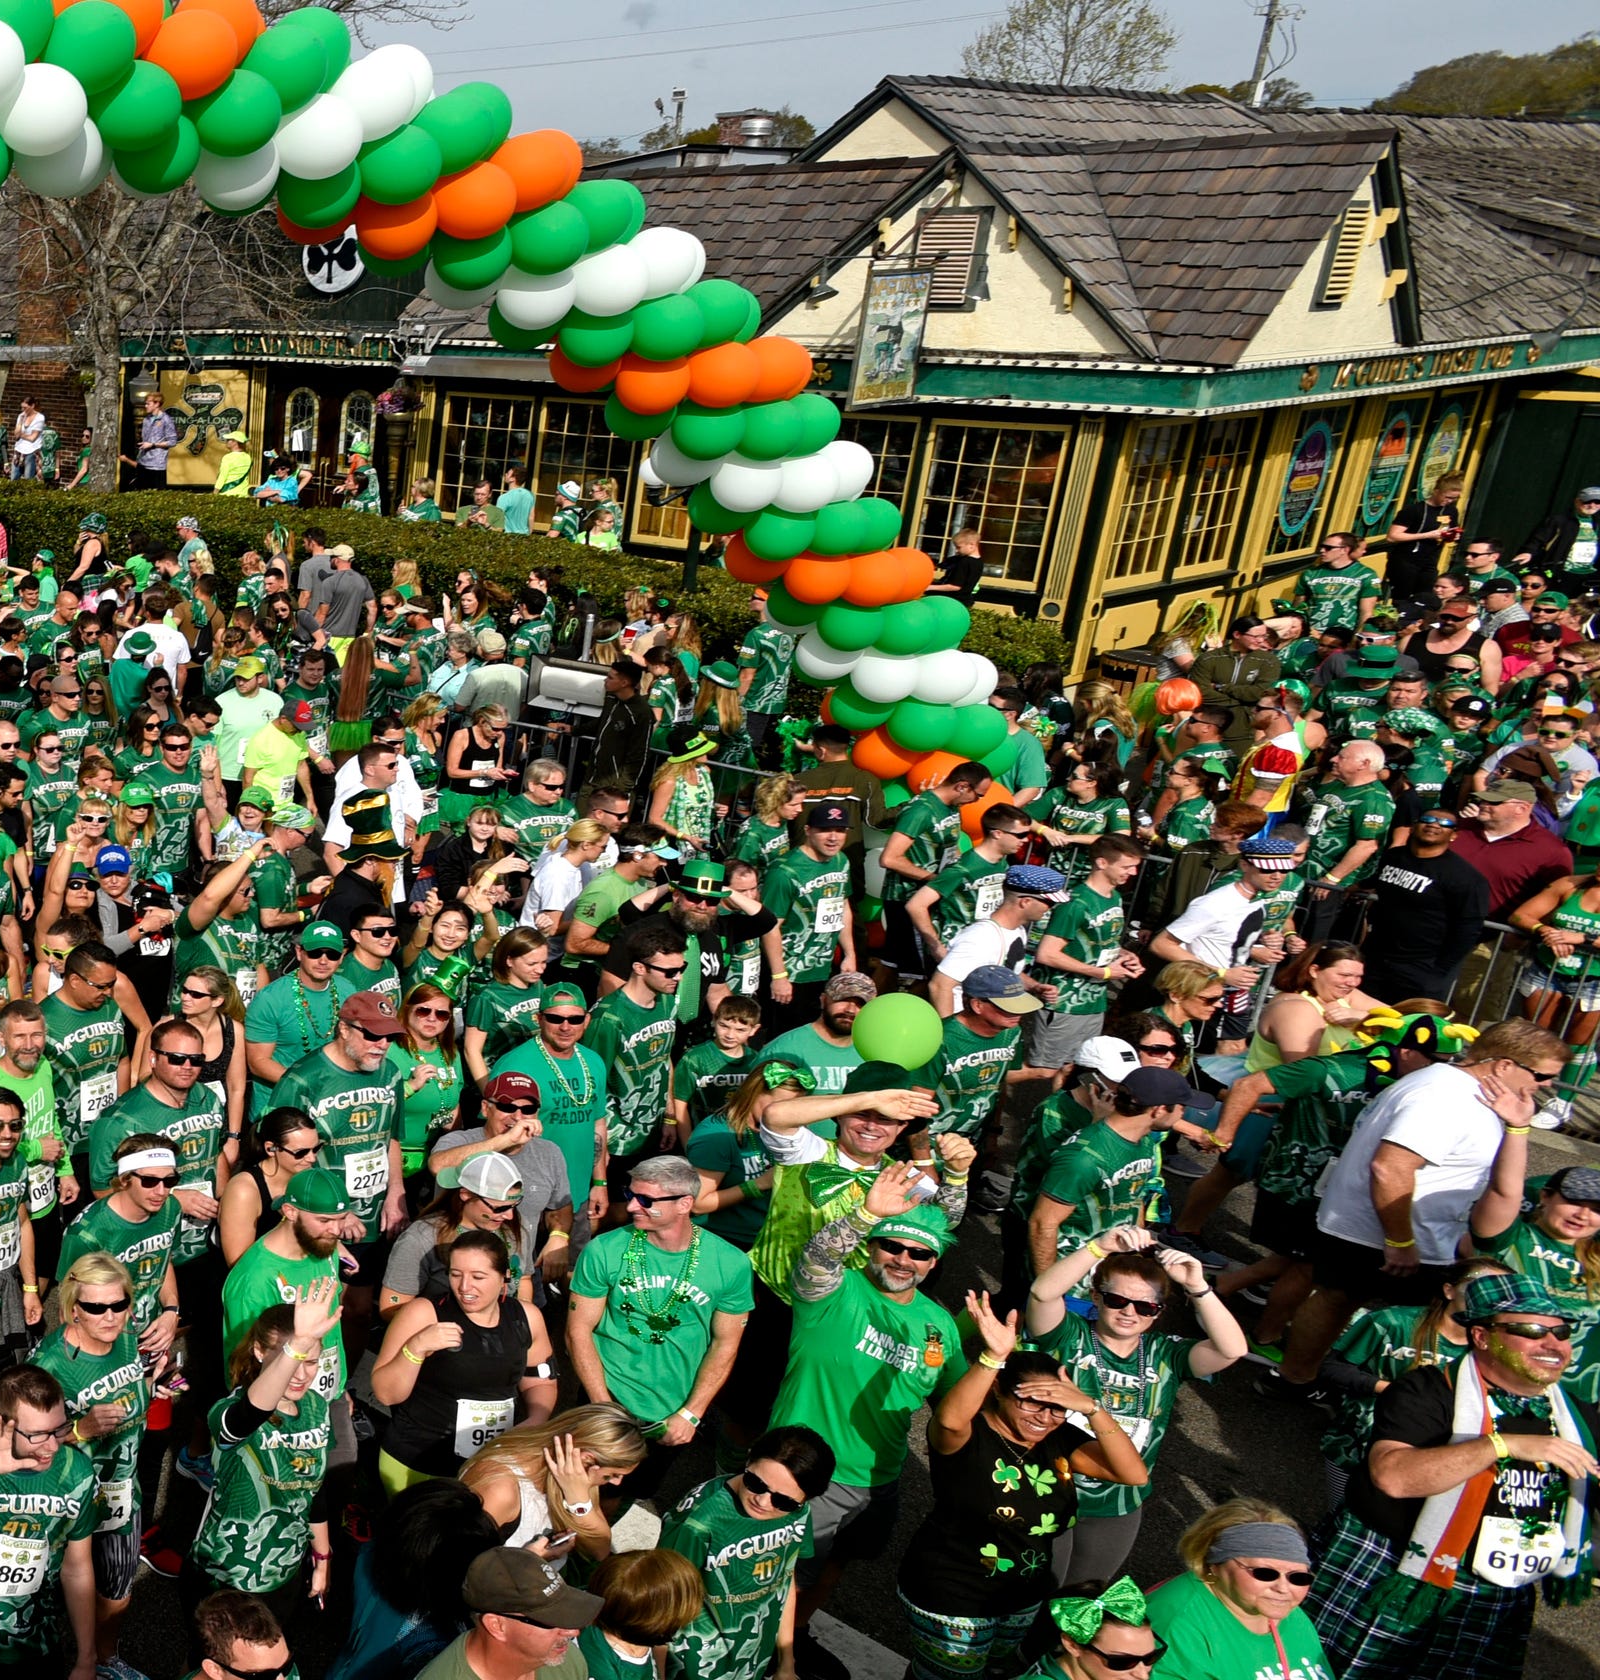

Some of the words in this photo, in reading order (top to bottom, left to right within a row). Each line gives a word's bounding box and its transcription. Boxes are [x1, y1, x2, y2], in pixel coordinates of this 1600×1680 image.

[1429, 347, 1480, 377] IRISH
[1481, 345, 1514, 369] PUB
[1379, 864, 1432, 893] SECURITY
[810, 1066, 857, 1091] LUC
[87, 1092, 115, 1112] 2738
[353, 1170, 386, 1191] 2277
[1488, 1550, 1553, 1574] 6190
